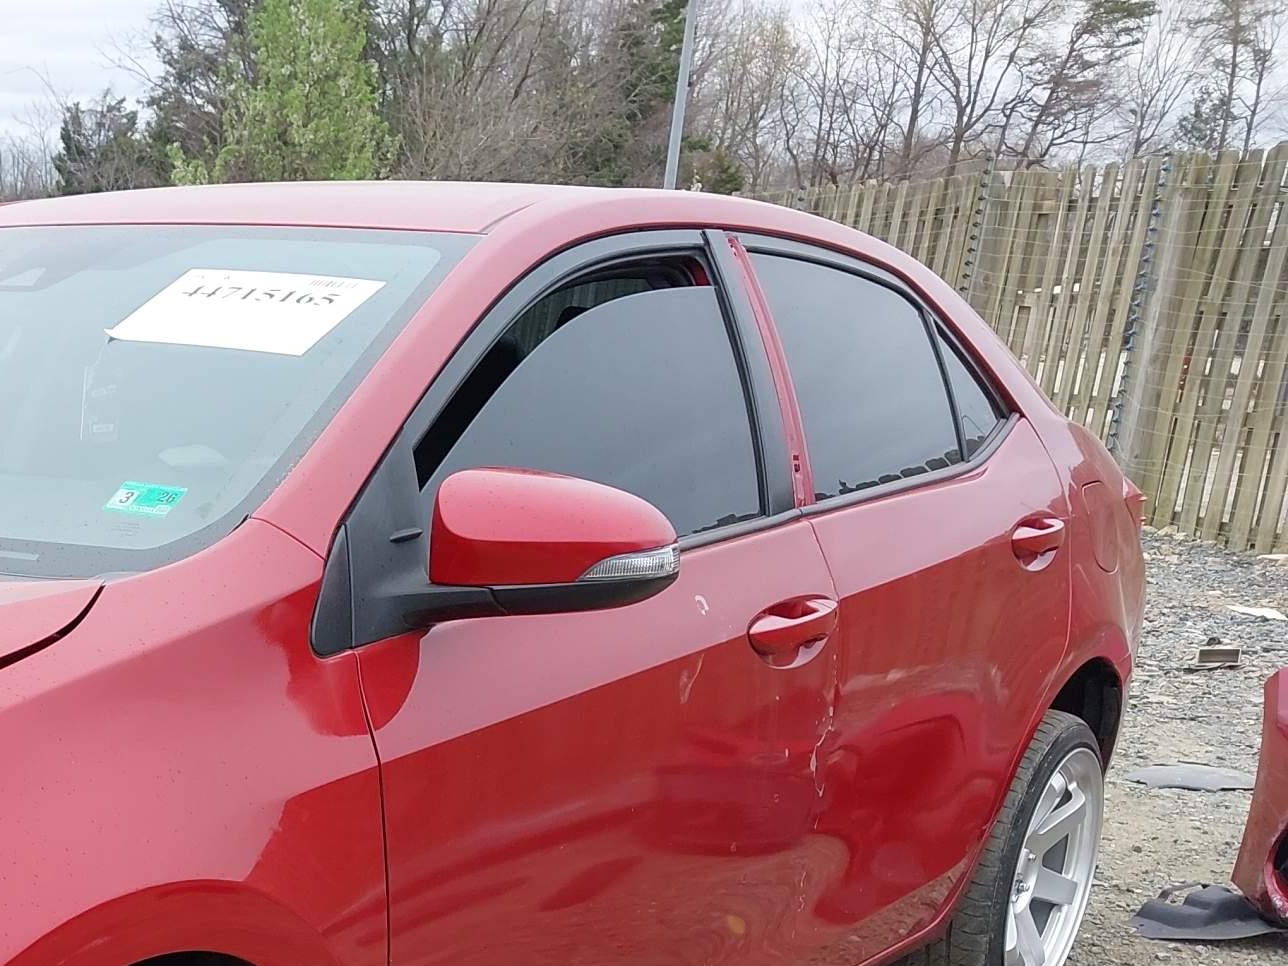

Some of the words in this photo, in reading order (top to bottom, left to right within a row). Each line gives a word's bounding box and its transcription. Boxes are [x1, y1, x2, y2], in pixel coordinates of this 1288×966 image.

[182, 285, 342, 306] 44715165
[118, 491, 135, 504] 3
[156, 491, 178, 504] 26
